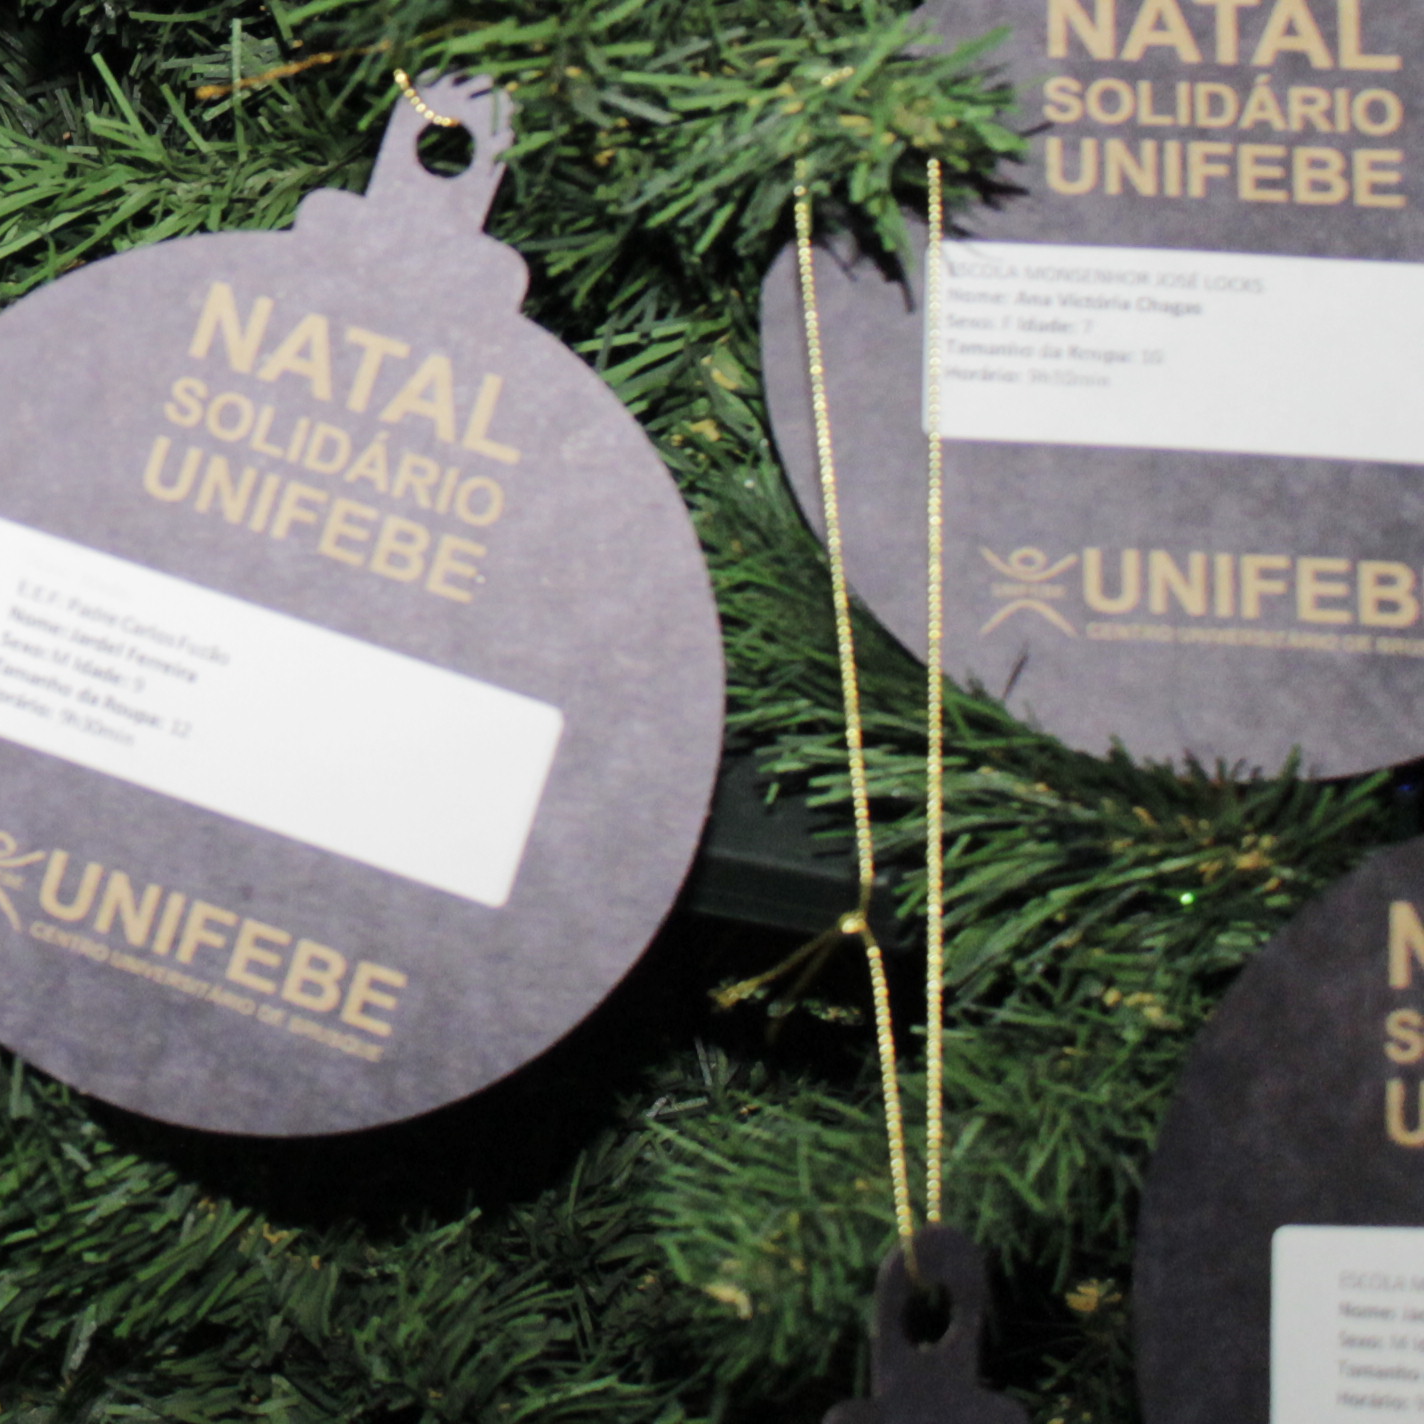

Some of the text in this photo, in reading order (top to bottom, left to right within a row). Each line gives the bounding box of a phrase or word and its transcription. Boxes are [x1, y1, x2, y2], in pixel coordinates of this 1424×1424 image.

[1042, 73, 1405, 138] SOLIDÁRIO
[1045, 136, 1407, 209] UNIFEBE
[188, 280, 521, 465] NATAL
[143, 435, 487, 603] UNIFEBE
[164, 376, 505, 527] SOLIDÁRIO
[1082, 546, 1424, 629] UNIFEB
[38, 849, 408, 1038] UNIFEBE
